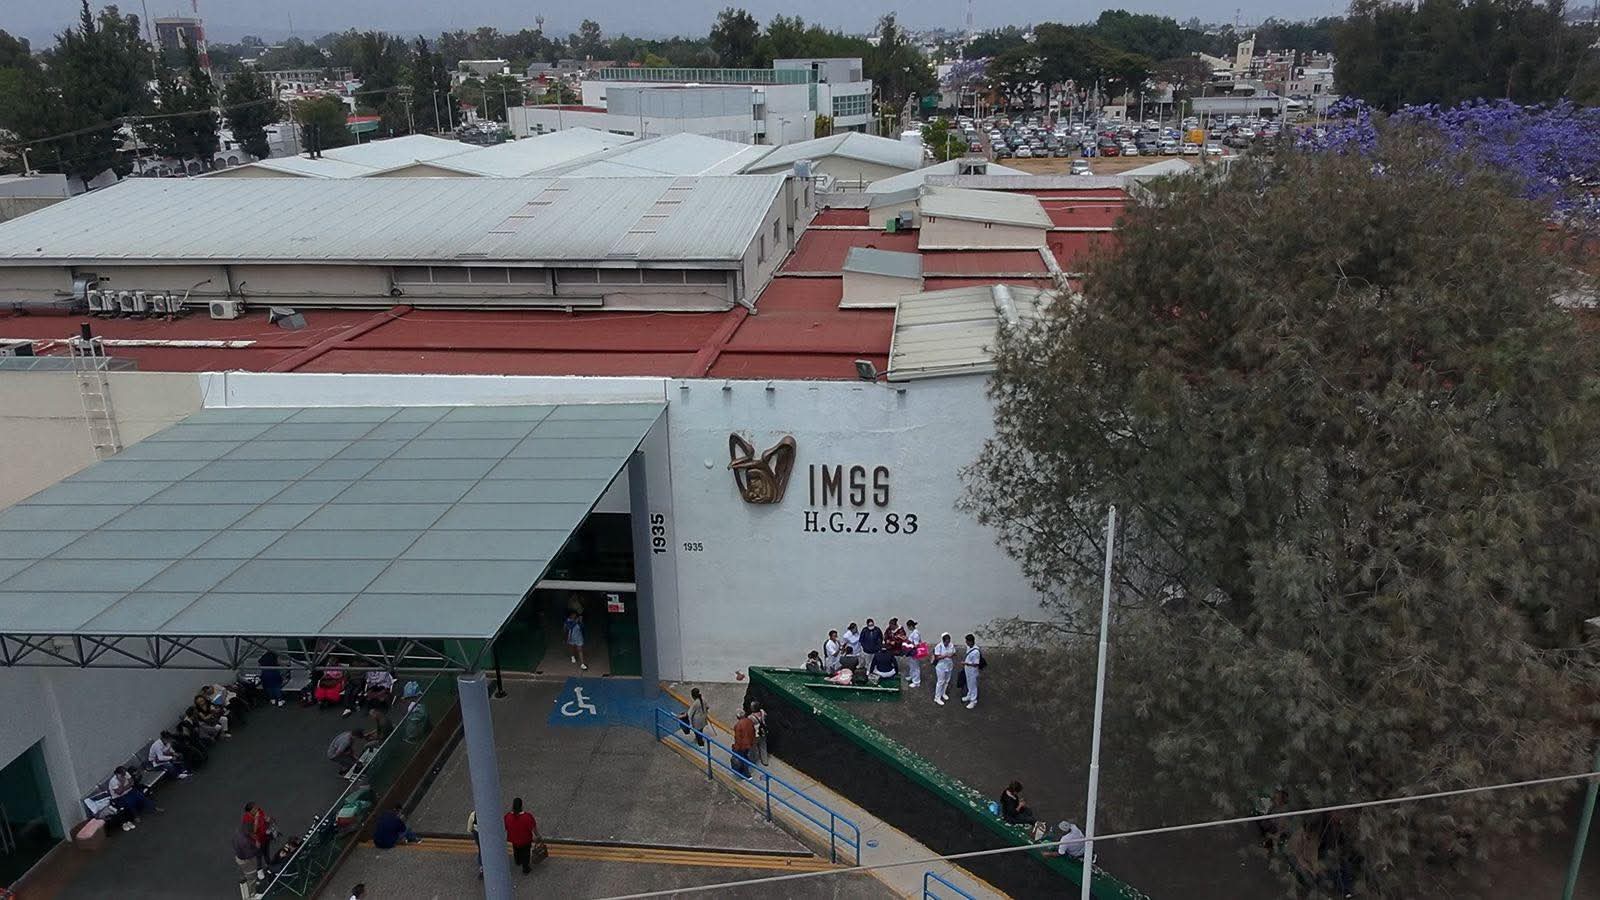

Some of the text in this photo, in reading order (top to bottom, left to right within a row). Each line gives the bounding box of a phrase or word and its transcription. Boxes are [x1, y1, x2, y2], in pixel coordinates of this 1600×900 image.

[809, 464, 890, 507] IMSS
[650, 514, 667, 554] 1935
[804, 511, 918, 534] H.G.Z. 83
[683, 542, 704, 552] 1935
